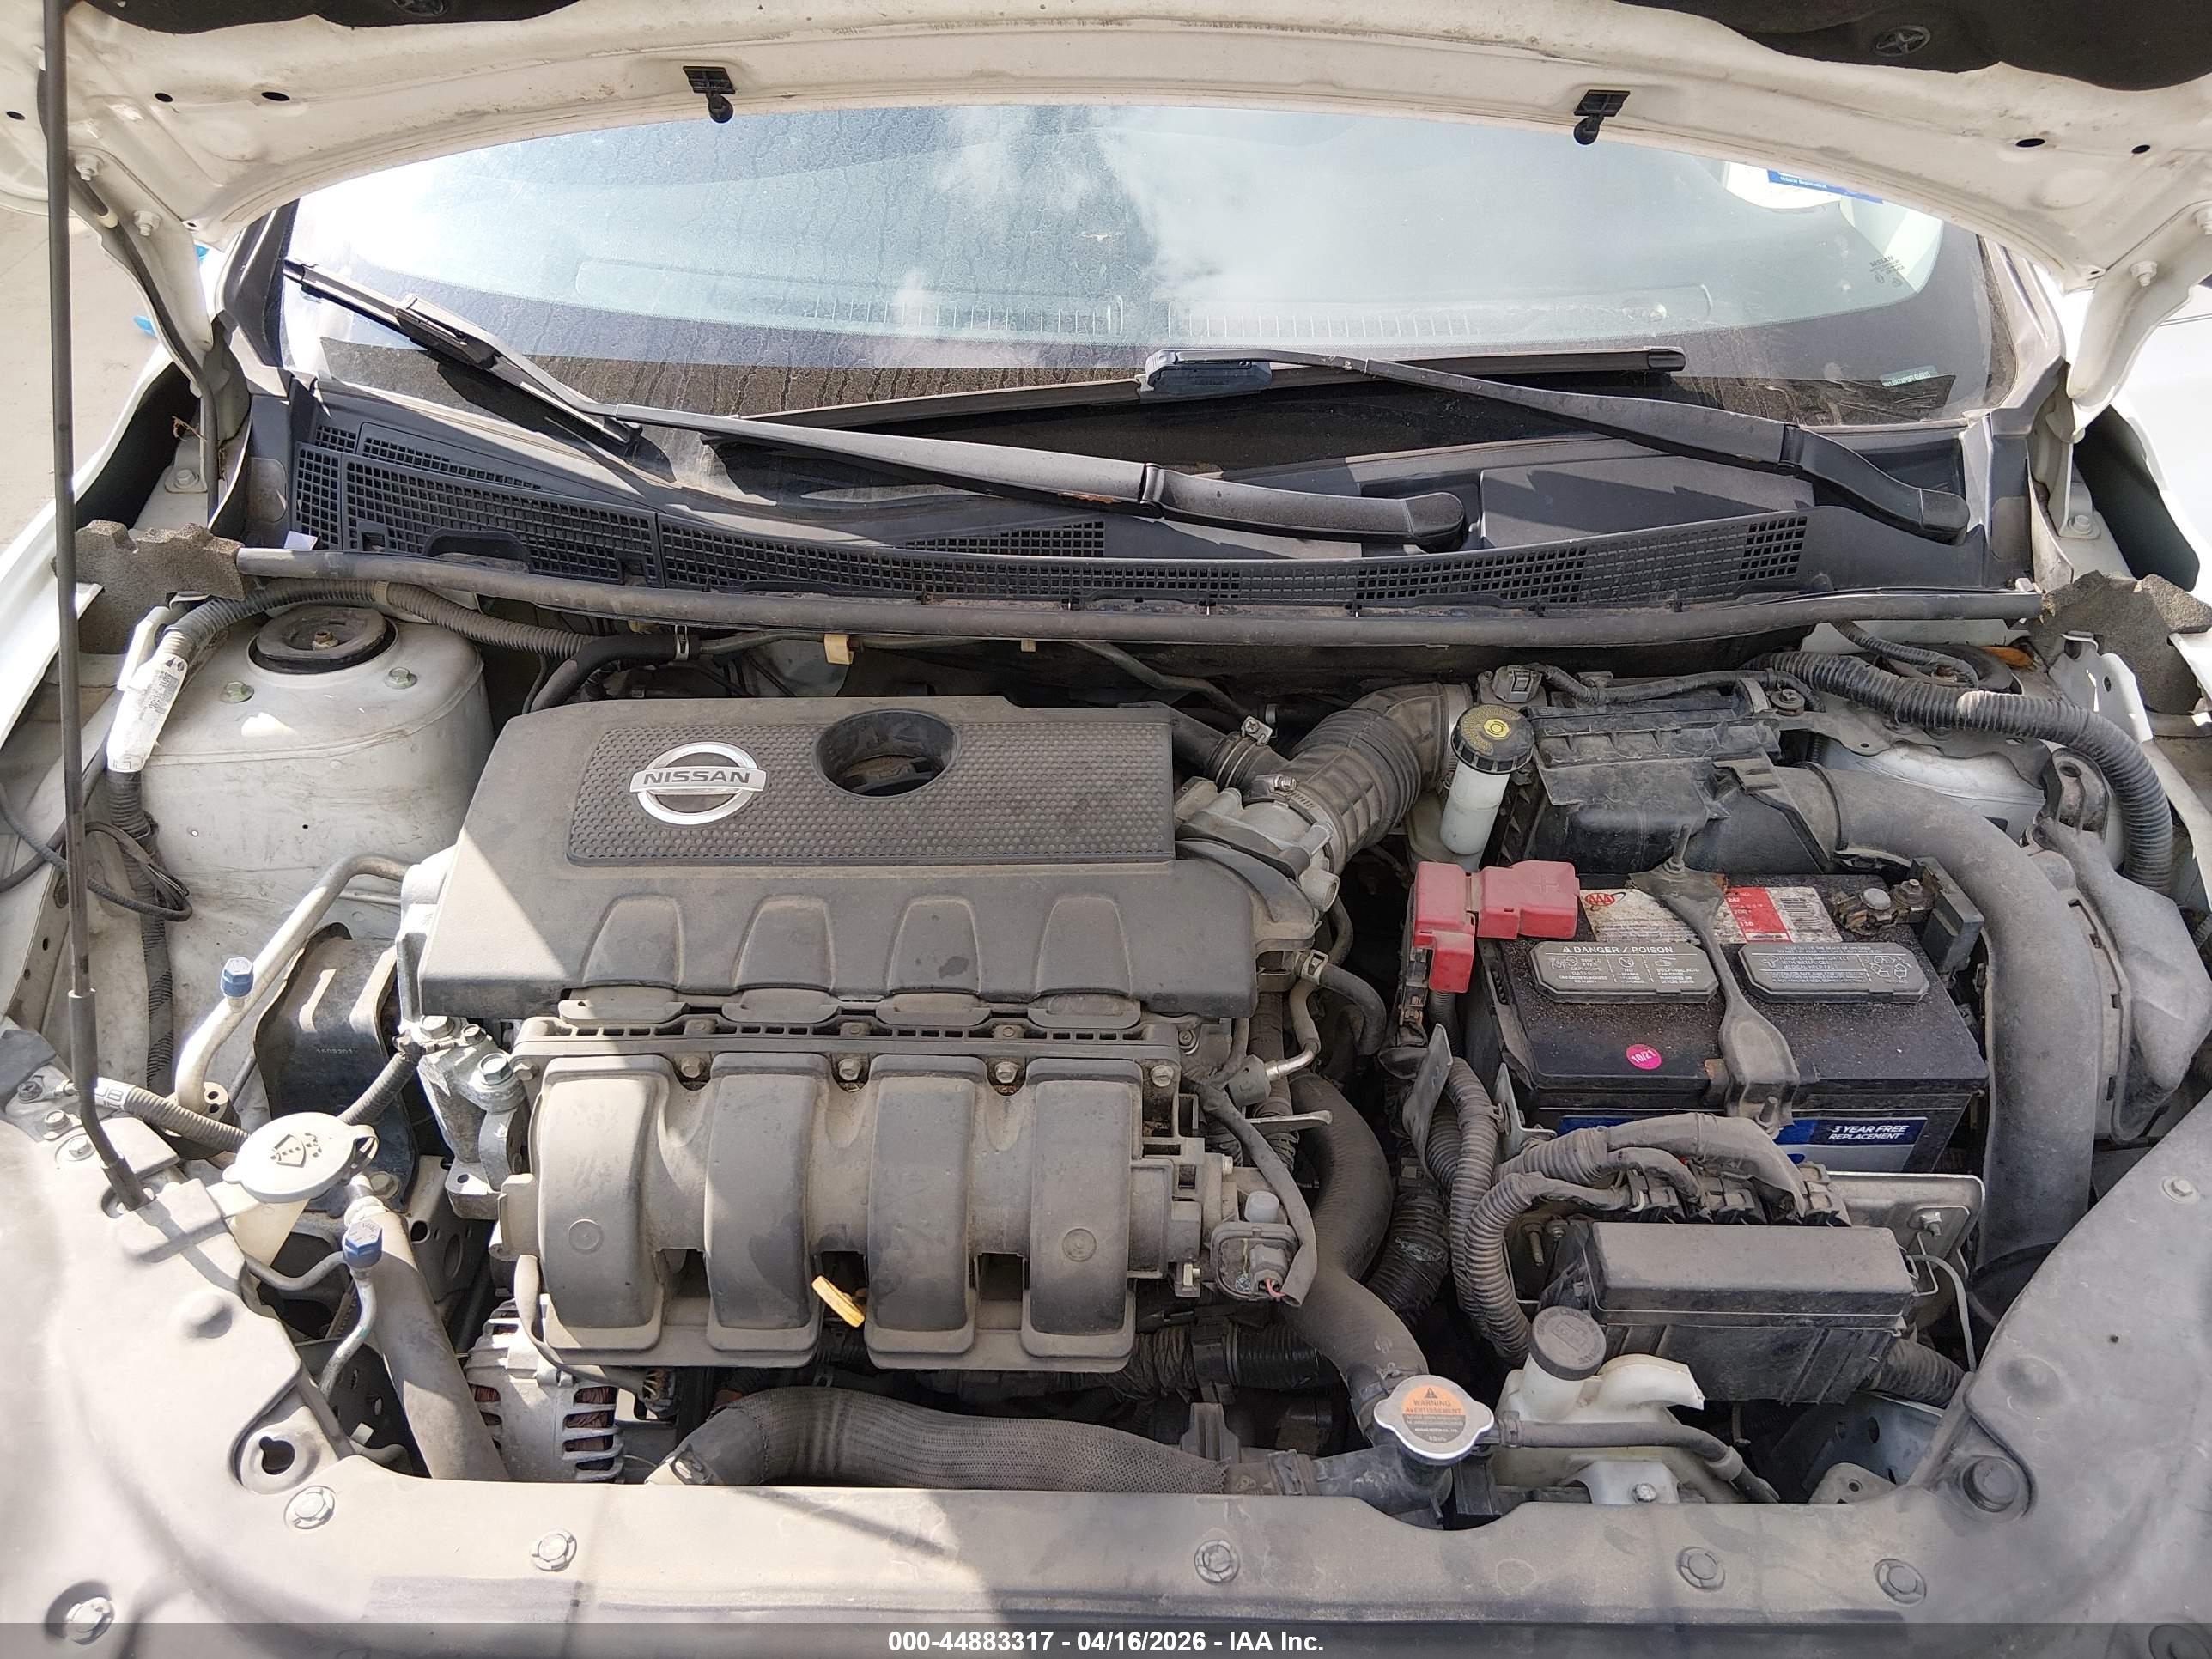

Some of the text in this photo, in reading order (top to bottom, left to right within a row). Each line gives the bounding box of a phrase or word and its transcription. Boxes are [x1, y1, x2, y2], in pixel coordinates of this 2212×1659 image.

[643, 771, 750, 785] NISSAN
[1586, 893, 1615, 905] AAA
[1631, 1049, 1656, 1064] 10/21
[1844, 1125, 1876, 1133] YEAR
